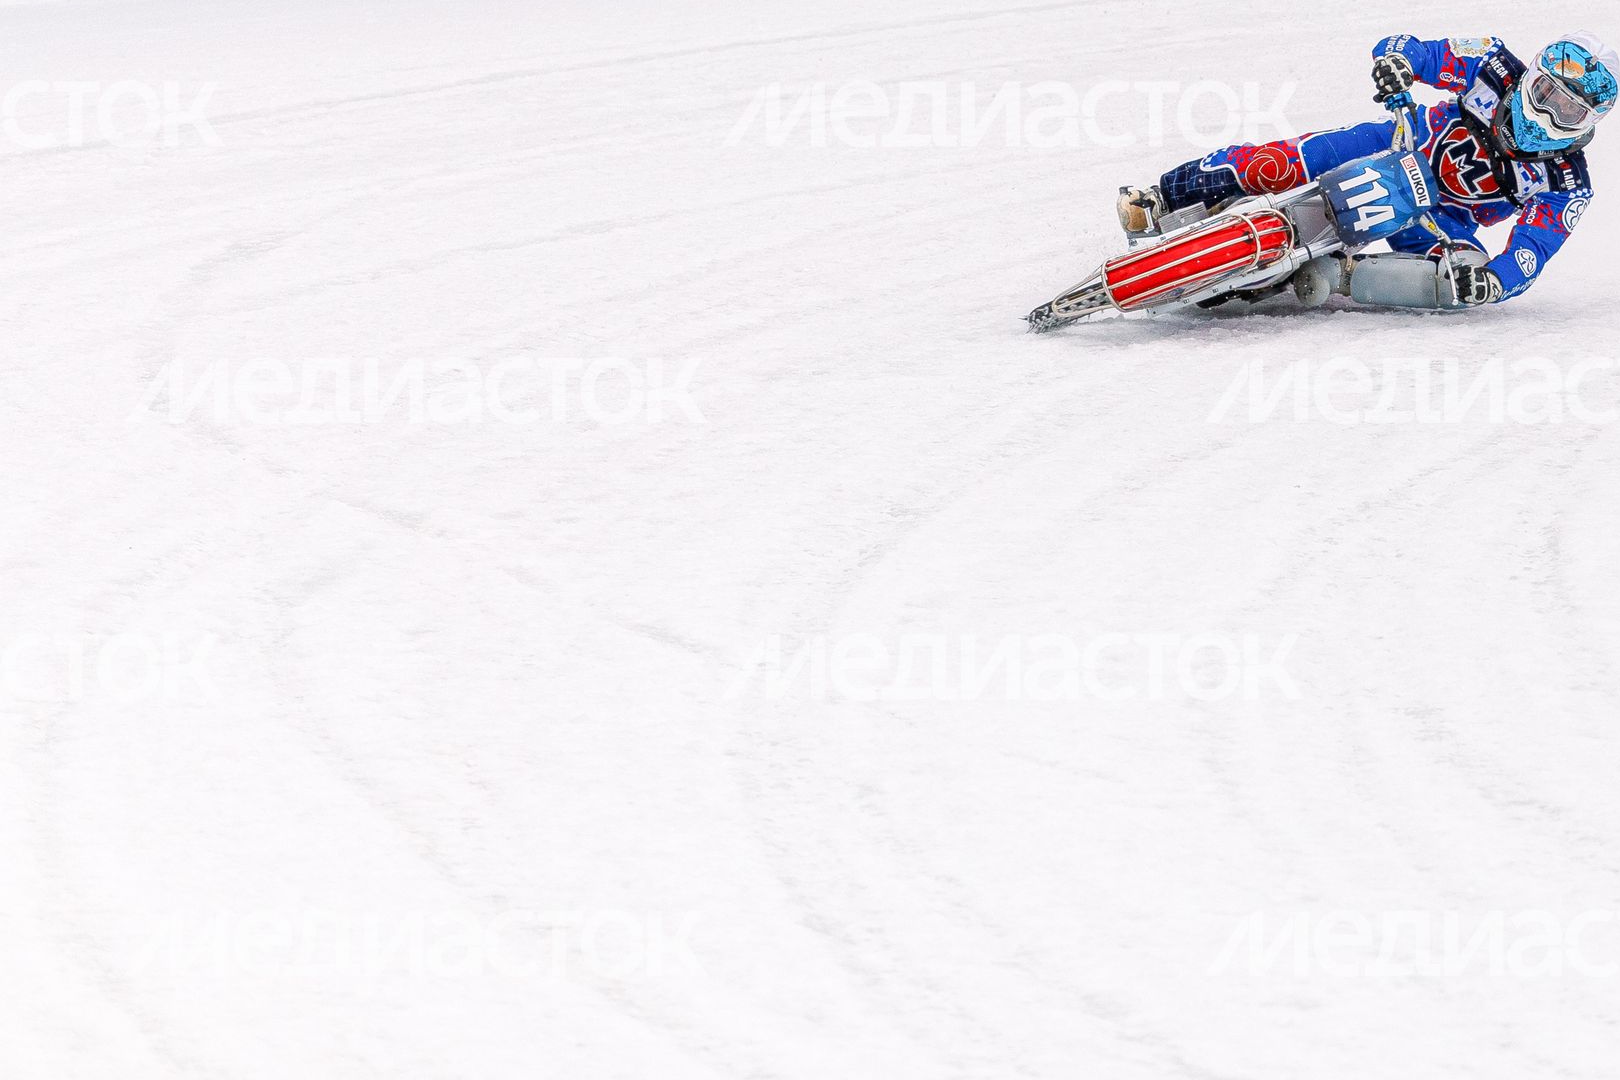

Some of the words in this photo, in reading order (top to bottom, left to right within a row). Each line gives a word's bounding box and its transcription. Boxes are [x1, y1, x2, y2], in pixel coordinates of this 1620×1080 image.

[1408, 168, 1431, 205] LUKOIL
[1562, 168, 1577, 191] LADA
[1339, 166, 1395, 233] 114
